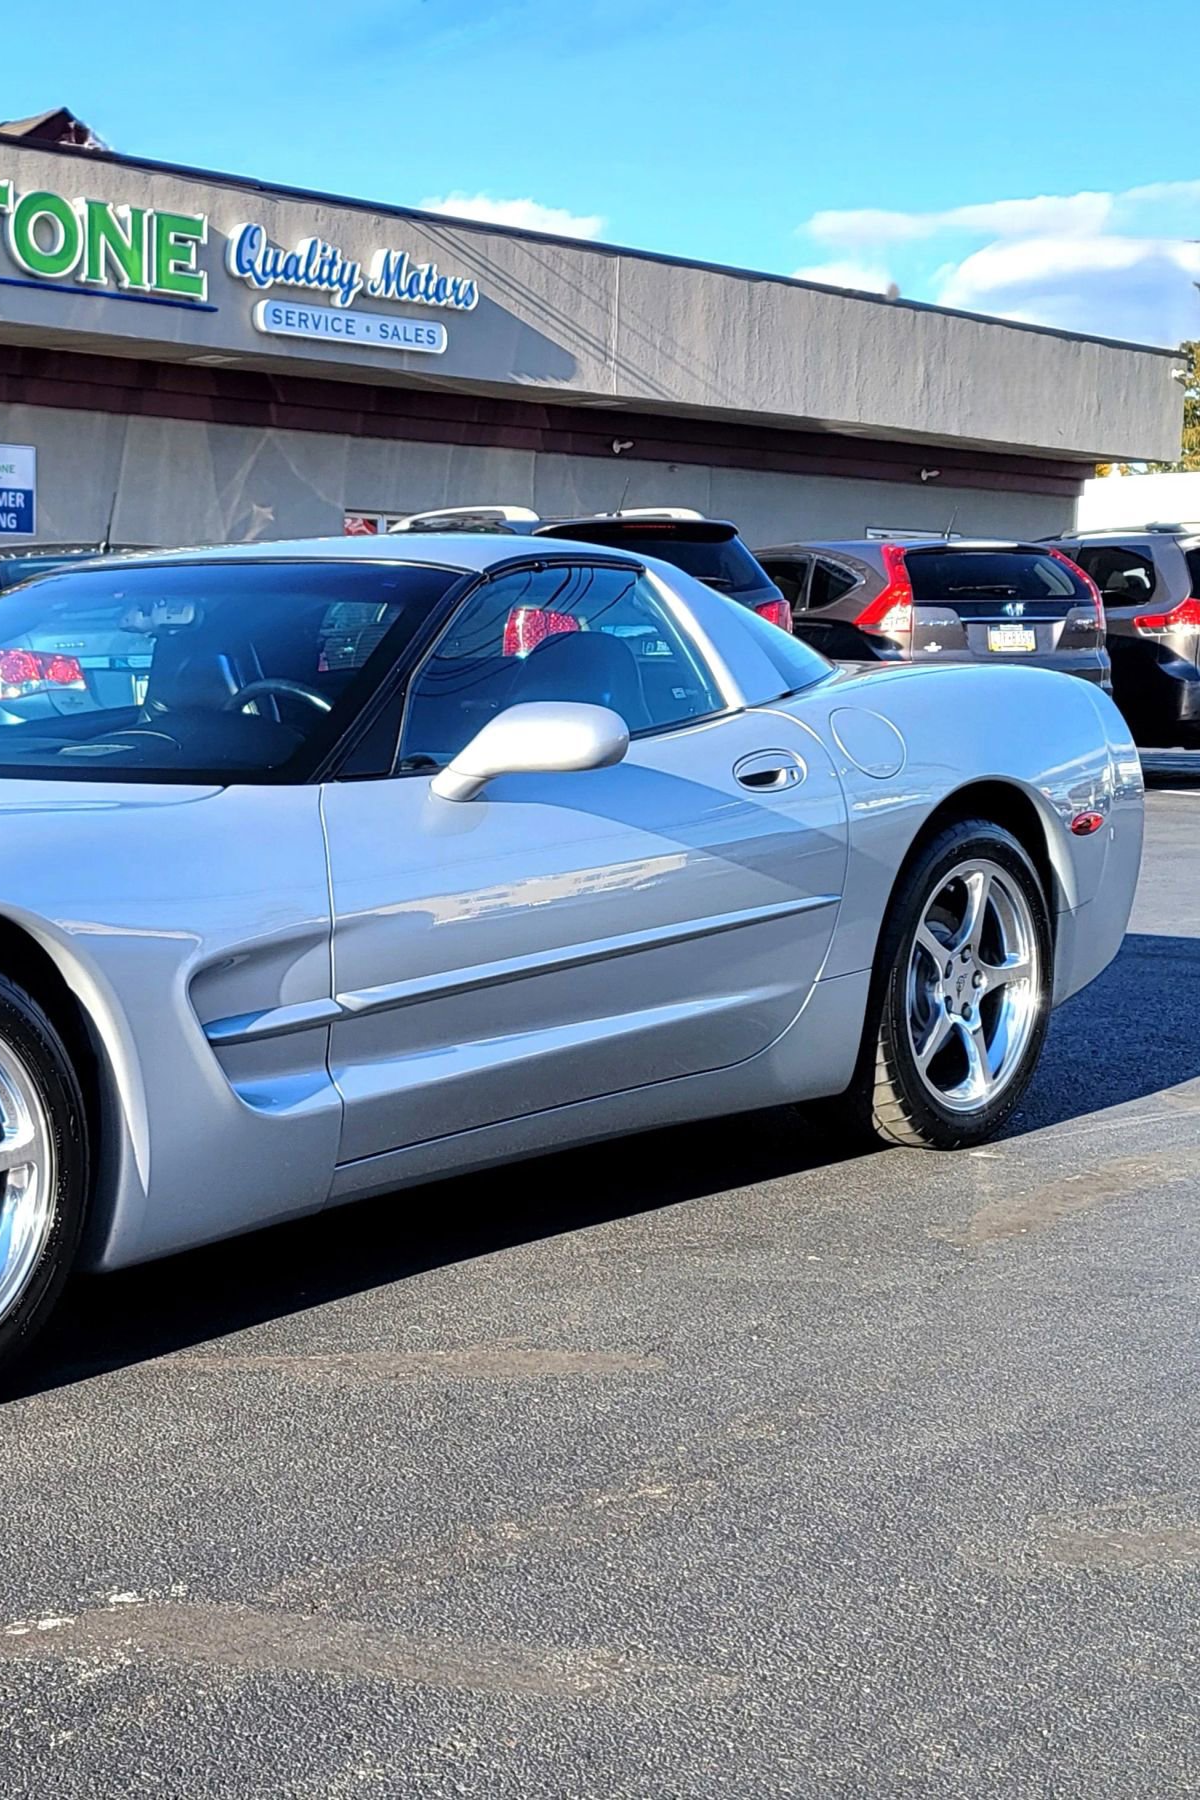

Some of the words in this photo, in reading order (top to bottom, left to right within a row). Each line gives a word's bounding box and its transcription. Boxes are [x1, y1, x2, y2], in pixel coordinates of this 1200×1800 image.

[234, 222, 362, 306] Quality
[367, 248, 479, 310] Motors
[271, 307, 356, 335] SERVICE
[379, 322, 436, 345] SALES
